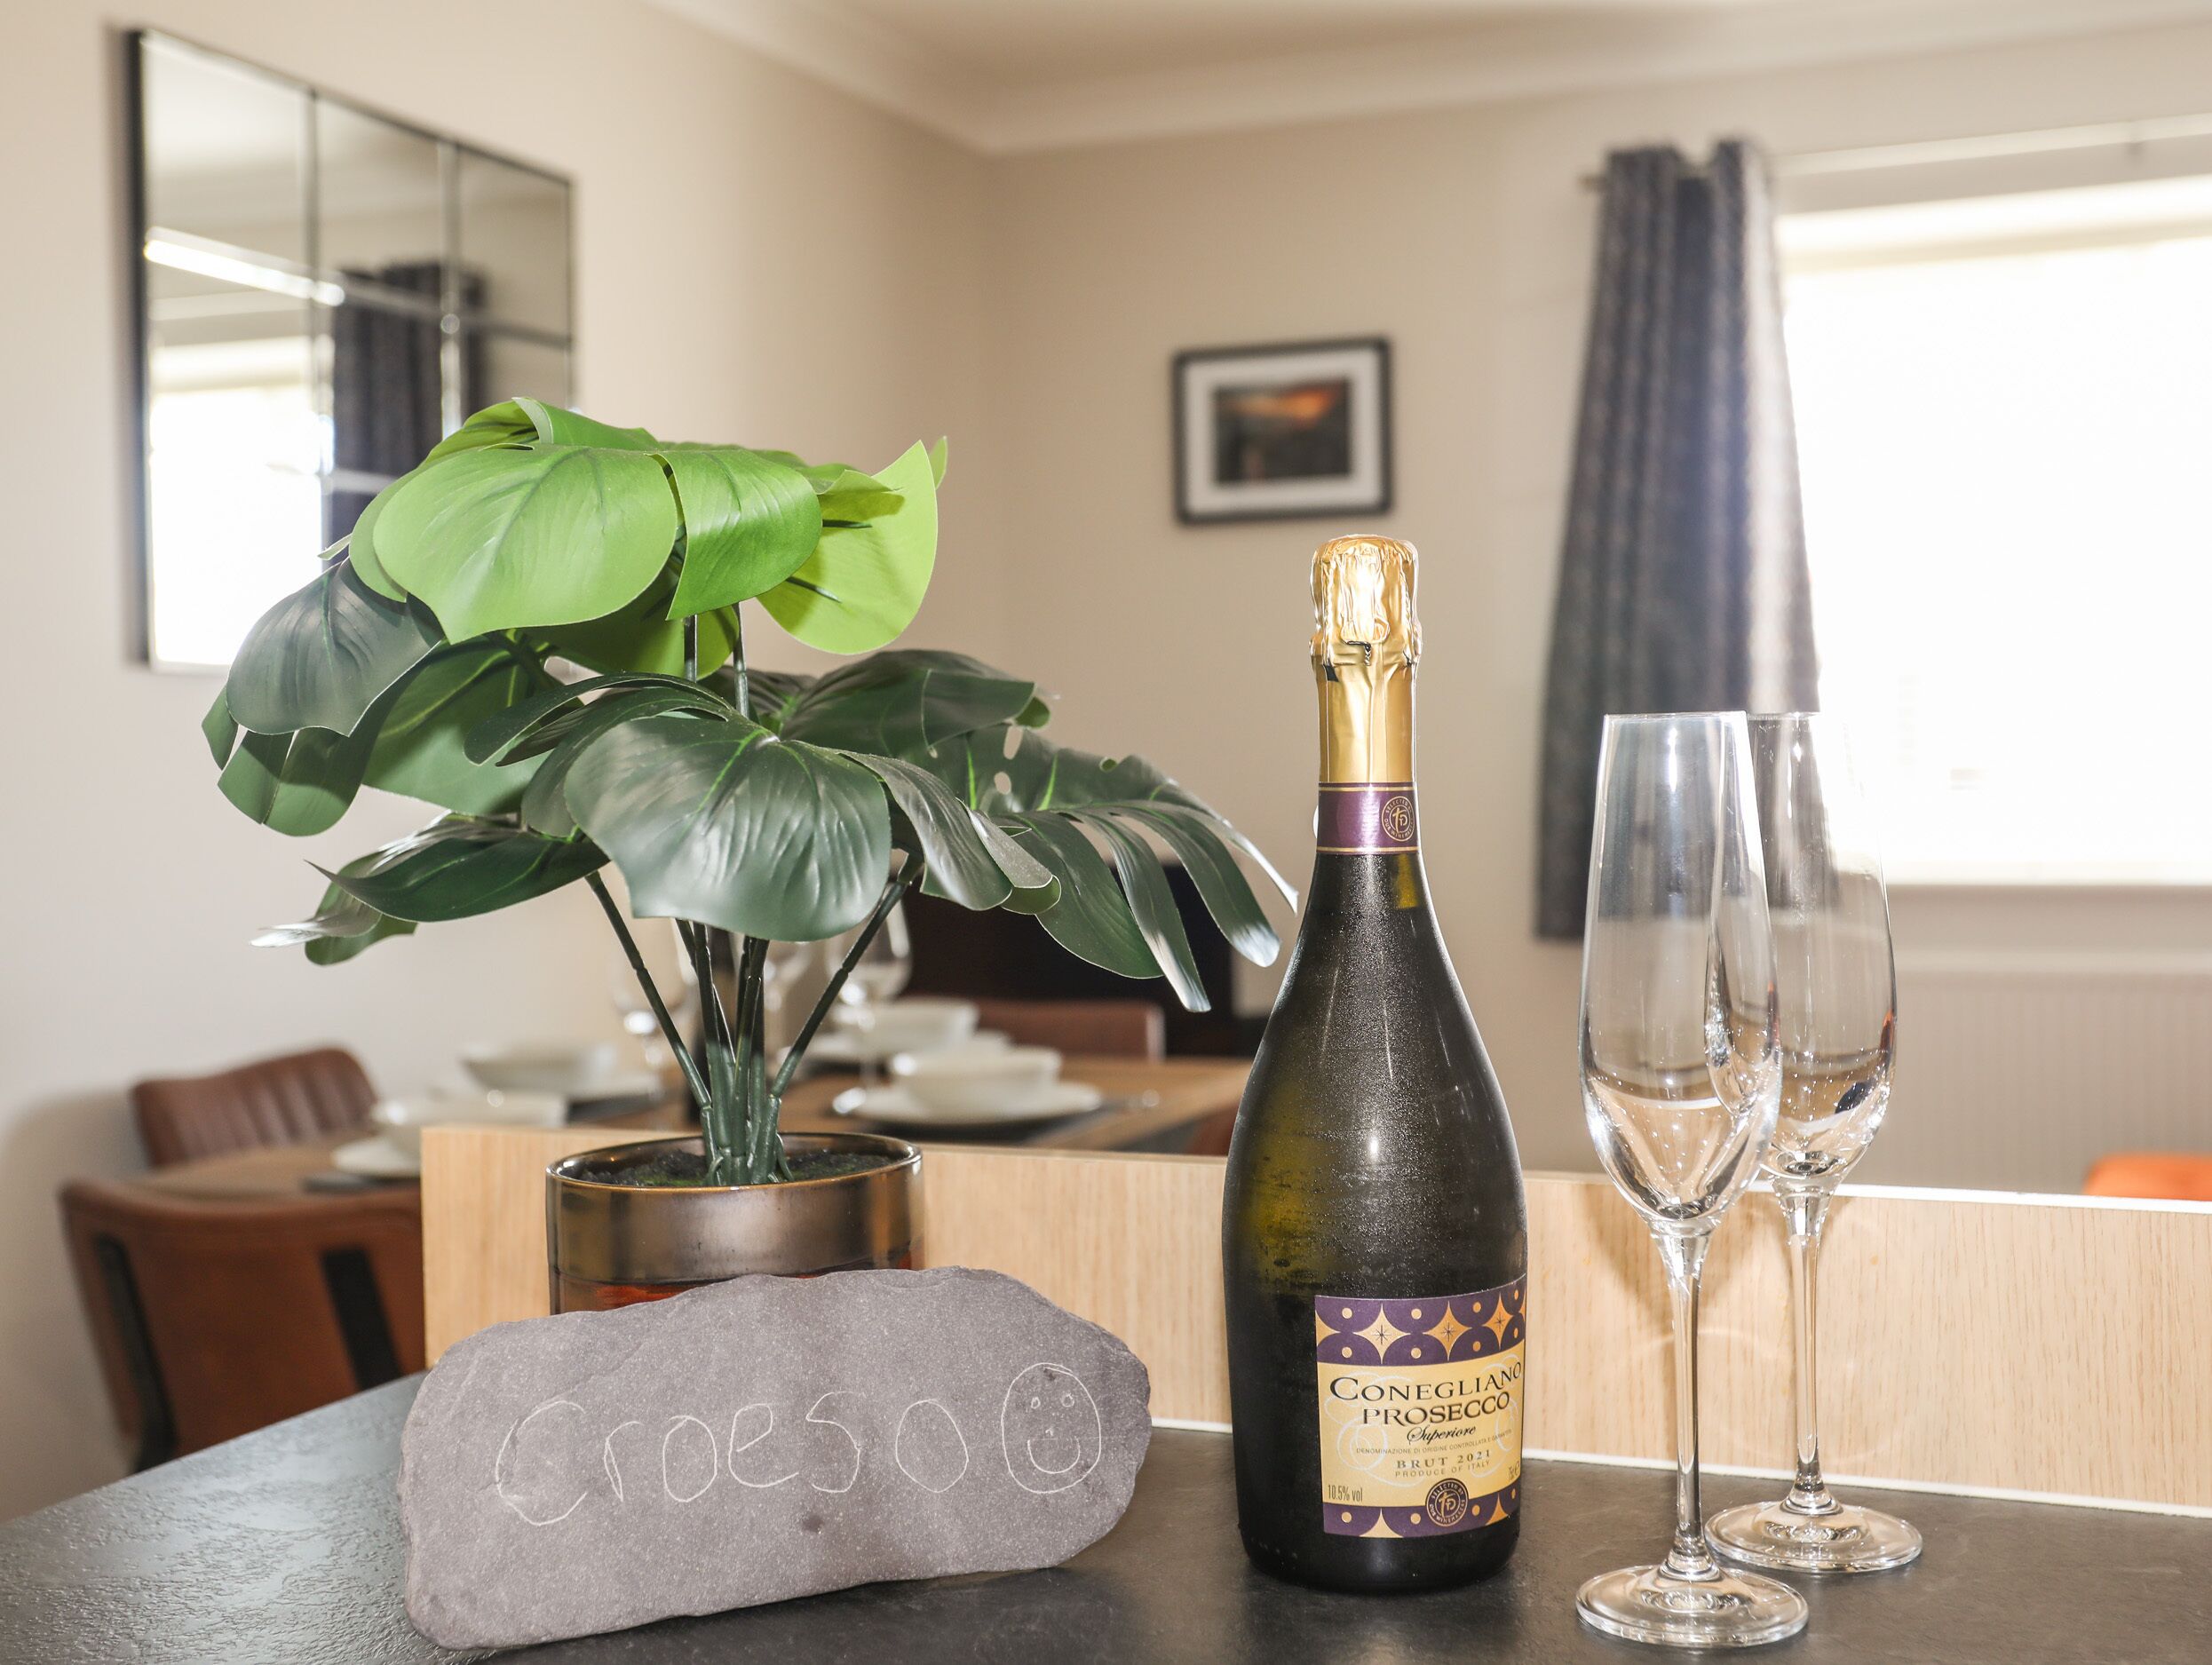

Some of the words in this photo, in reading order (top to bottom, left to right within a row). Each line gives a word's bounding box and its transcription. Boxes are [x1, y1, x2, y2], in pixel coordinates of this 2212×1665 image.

[1330, 1361, 1522, 1402] CONEGLIANO
[1363, 1391, 1510, 1427] PROSECCO
[1407, 1424, 1476, 1445] Superiore
[1449, 1437, 1486, 1450] CONTROLLATA
[496, 1391, 970, 1526] Croeso
[1397, 1456, 1448, 1469] BRUT
[1457, 1449, 1490, 1463] 2021
[1395, 1466, 1446, 1478] PRODUCE
[1468, 1460, 1490, 1471] ITALY
[1328, 1484, 1350, 1501] 10.5%
[1352, 1487, 1363, 1502] vol
